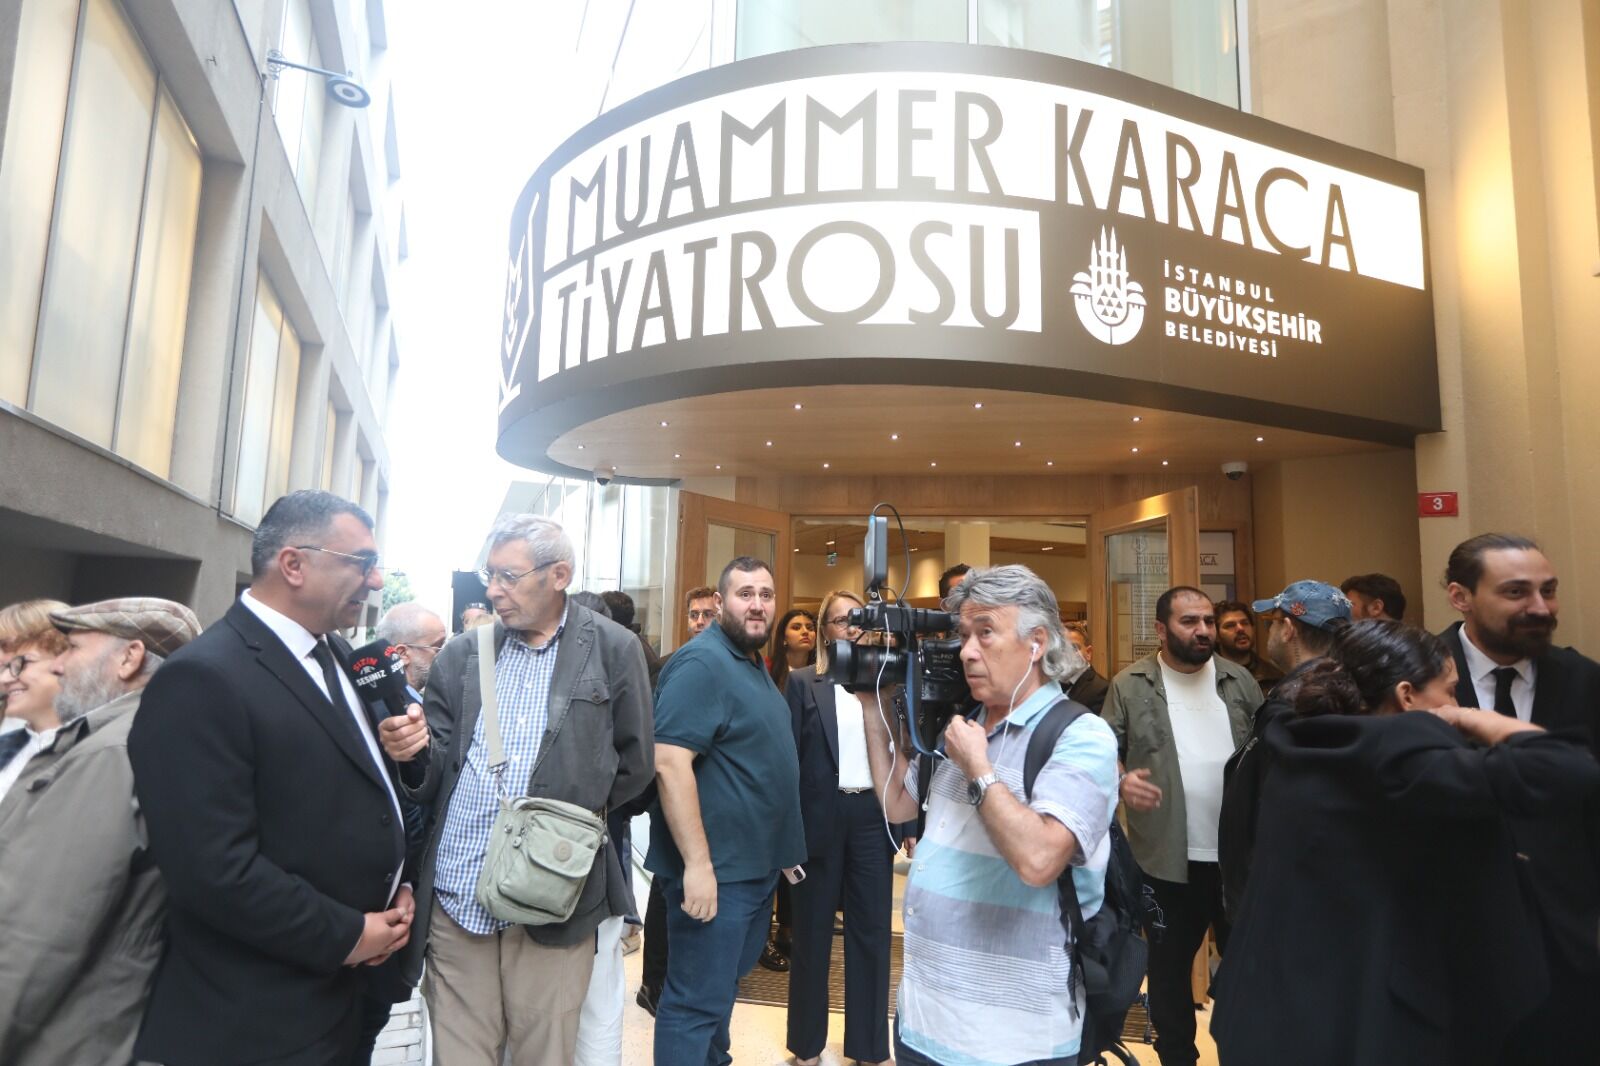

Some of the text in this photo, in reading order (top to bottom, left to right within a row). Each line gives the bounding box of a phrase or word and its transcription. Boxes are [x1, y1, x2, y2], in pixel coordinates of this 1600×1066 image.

[566, 88, 1358, 275] MUAMMER KARACA
[558, 220, 1020, 373] TİYATROSU
[1164, 259, 1275, 303] İSTANBUL
[1164, 286, 1323, 344] BÜYÜKŞEHİR
[1165, 320, 1277, 358] BELEDİYESİ
[1433, 497, 1443, 511] 3
